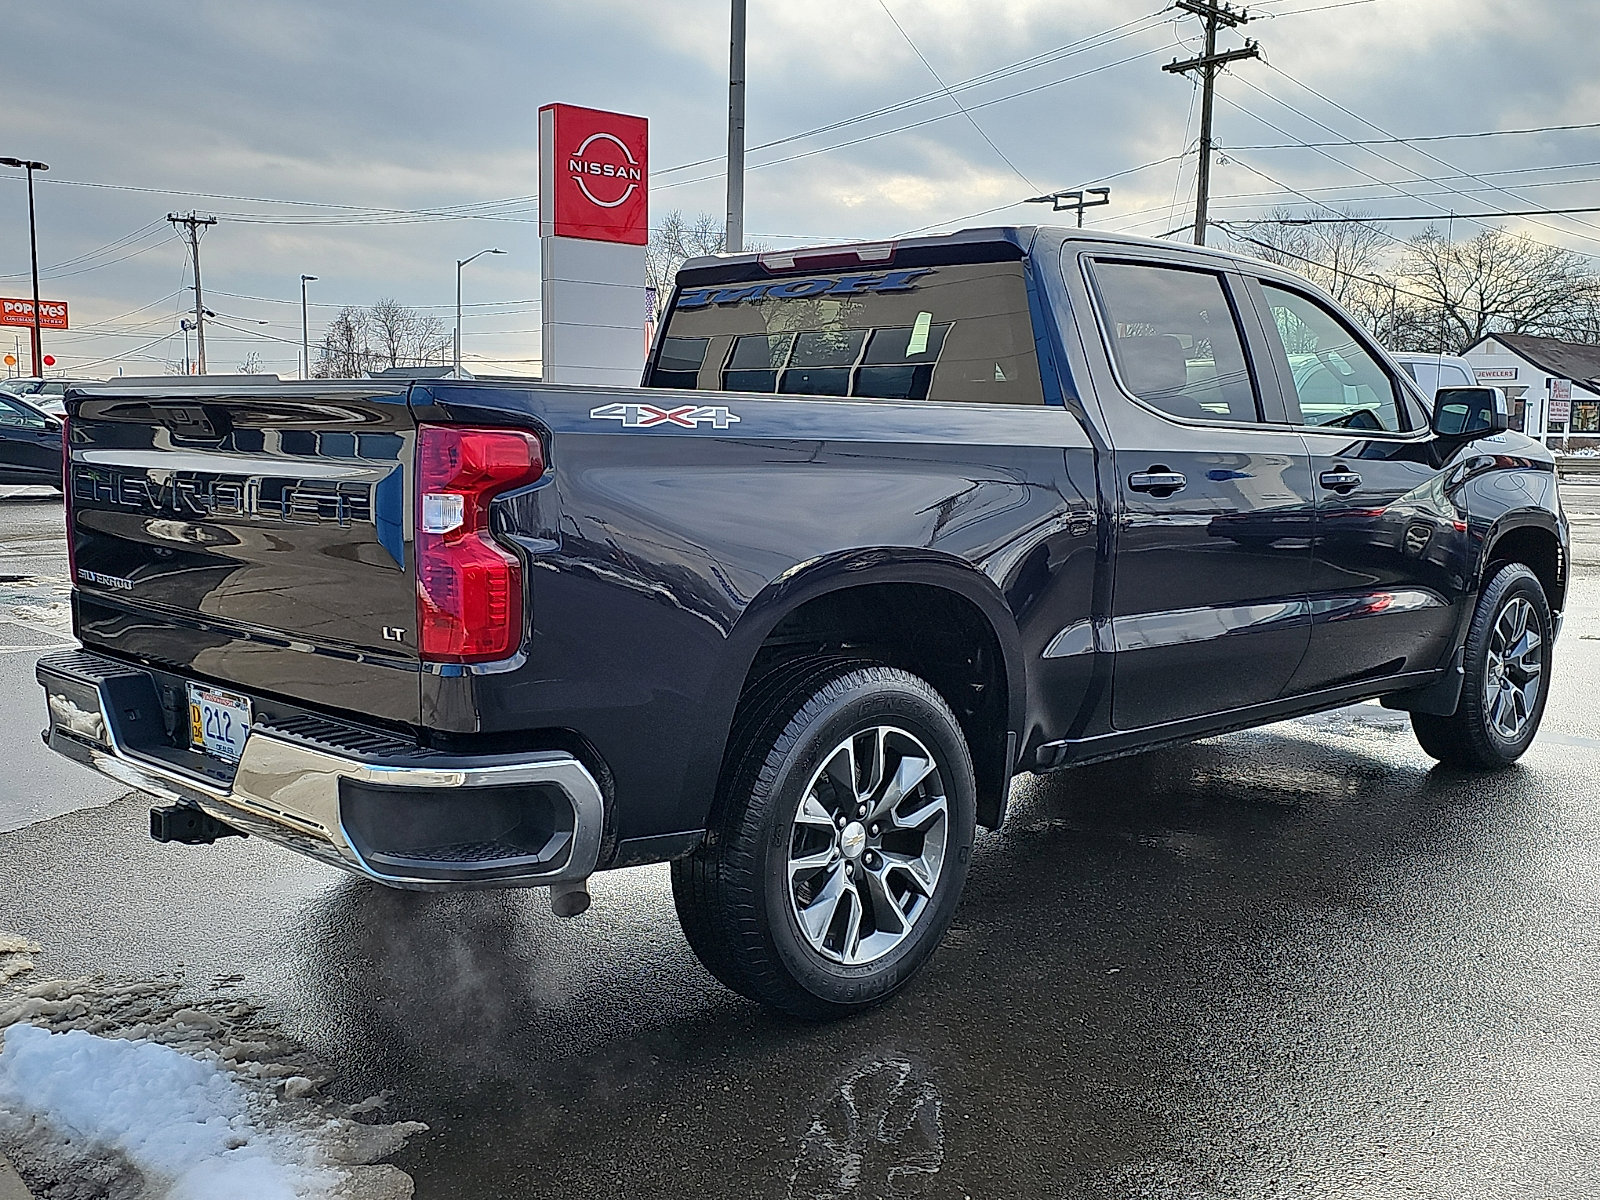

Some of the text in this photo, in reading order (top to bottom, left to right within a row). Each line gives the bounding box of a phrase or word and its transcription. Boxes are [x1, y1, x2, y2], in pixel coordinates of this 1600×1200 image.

[569, 159, 641, 181] NISSAN
[3, 302, 65, 317] POPYeS
[1476, 370, 1514, 379] JEWELERS
[73, 470, 368, 529] CHEVROLET
[78, 568, 135, 590] SILVERADO
[382, 625, 407, 642] LT
[203, 705, 236, 745] 212
